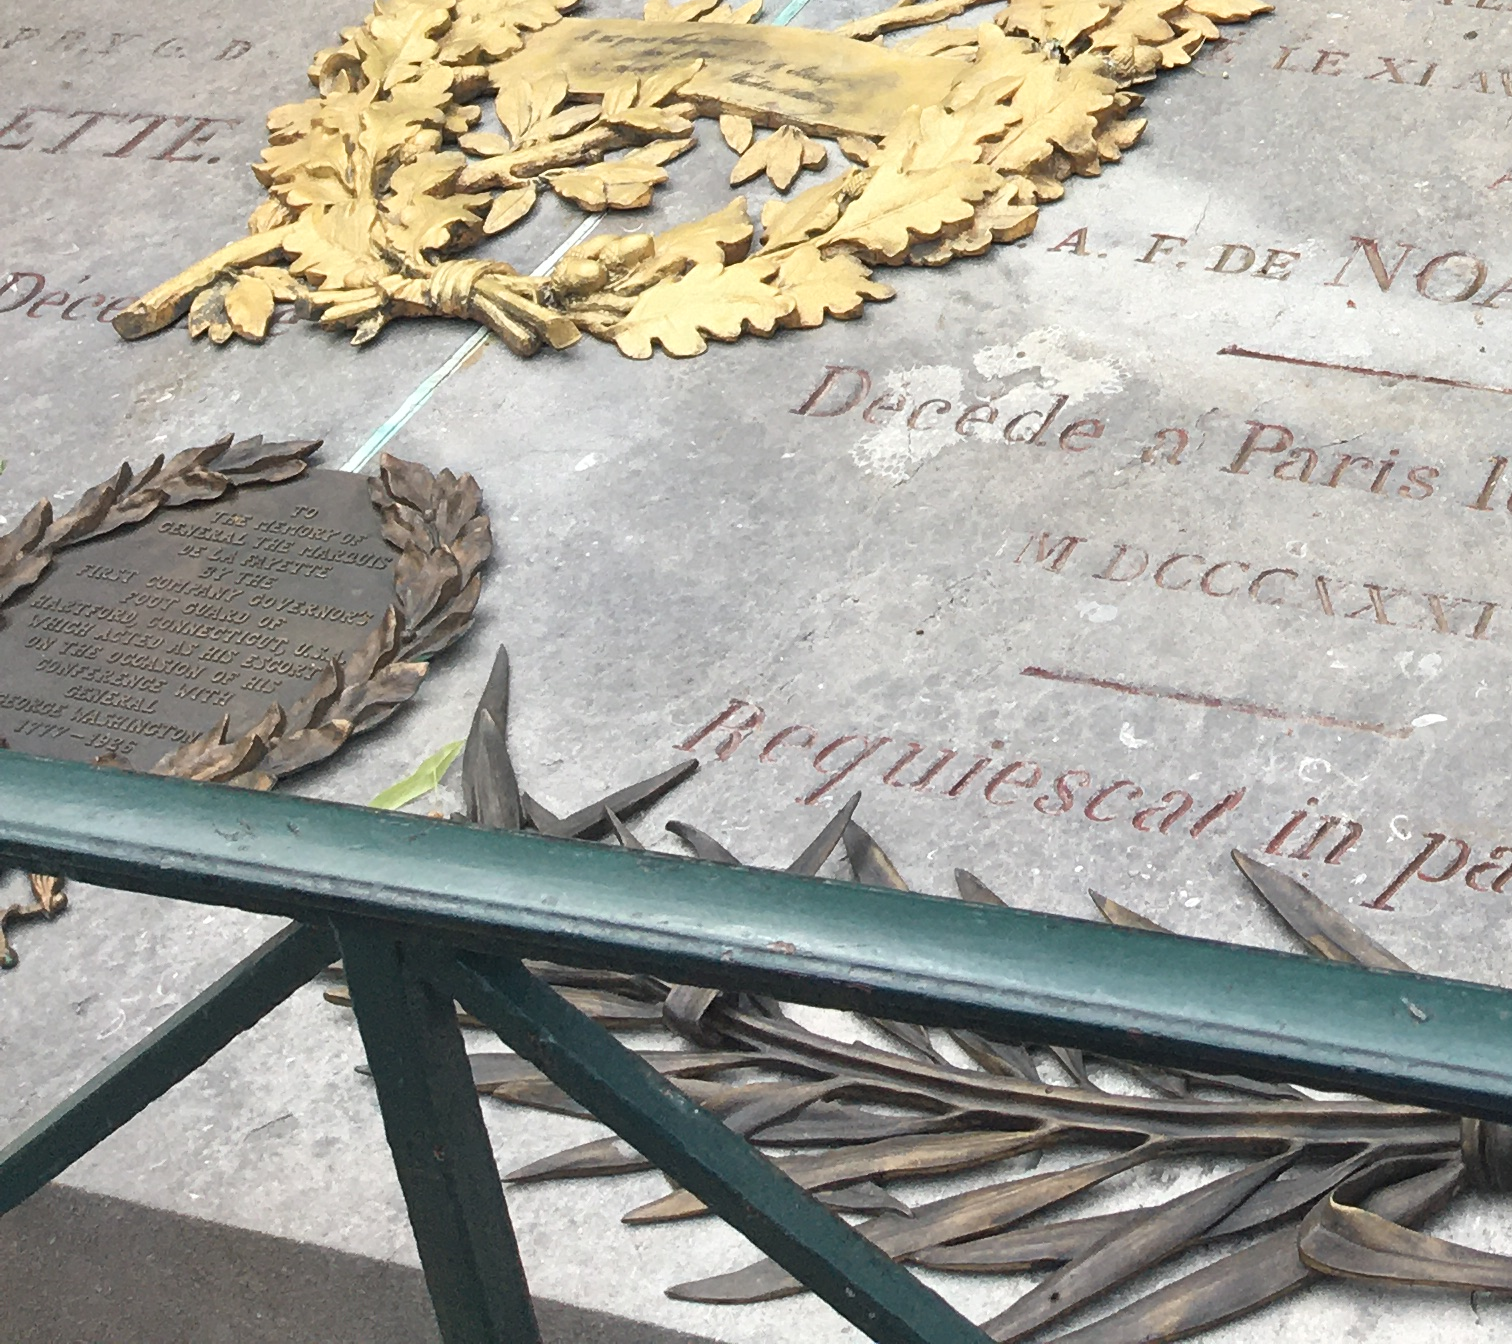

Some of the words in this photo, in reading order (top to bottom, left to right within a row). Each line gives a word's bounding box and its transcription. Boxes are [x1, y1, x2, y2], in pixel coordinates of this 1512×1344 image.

[1204, 243, 1301, 282] DE
[1222, 419, 1440, 501] Paris
[210, 512, 253, 527] THE
[254, 519, 341, 542] MEMORY
[340, 533, 368, 546] OF
[290, 505, 319, 519] TO
[158, 521, 249, 546] GENERAL
[252, 536, 295, 554] THE
[299, 545, 393, 571] MARQUIS
[178, 545, 207, 558] DE
[207, 548, 239, 565] LA
[240, 554, 333, 579] FAYETTE
[76, 563, 139, 585] FIRST
[145, 575, 244, 603] COMPANY
[198, 566, 233, 581] BY
[235, 572, 279, 589] THE
[119, 592, 179, 613] FOOT
[181, 602, 251, 626] GUARD
[258, 615, 288, 631] OF
[24, 636, 54, 651] ON
[59, 641, 103, 661] THE
[106, 650, 208, 680] OCCASION
[210, 669, 240, 685] OF
[241, 677, 283, 694] HIS
[28, 615, 92, 637] WHICH
[94, 628, 165, 650] ACTED
[166, 642, 196, 657] AS
[199, 647, 239, 664] HIS
[240, 655, 324, 681] ESCORT
[35, 658, 168, 693] CONFERENCE
[174, 683, 235, 707] WITH
[64, 685, 161, 714] GENERAL
[13, 719, 70, 739] 1777
[70, 706, 204, 744] WASHINGTON
[1264, 795, 1365, 865] in
